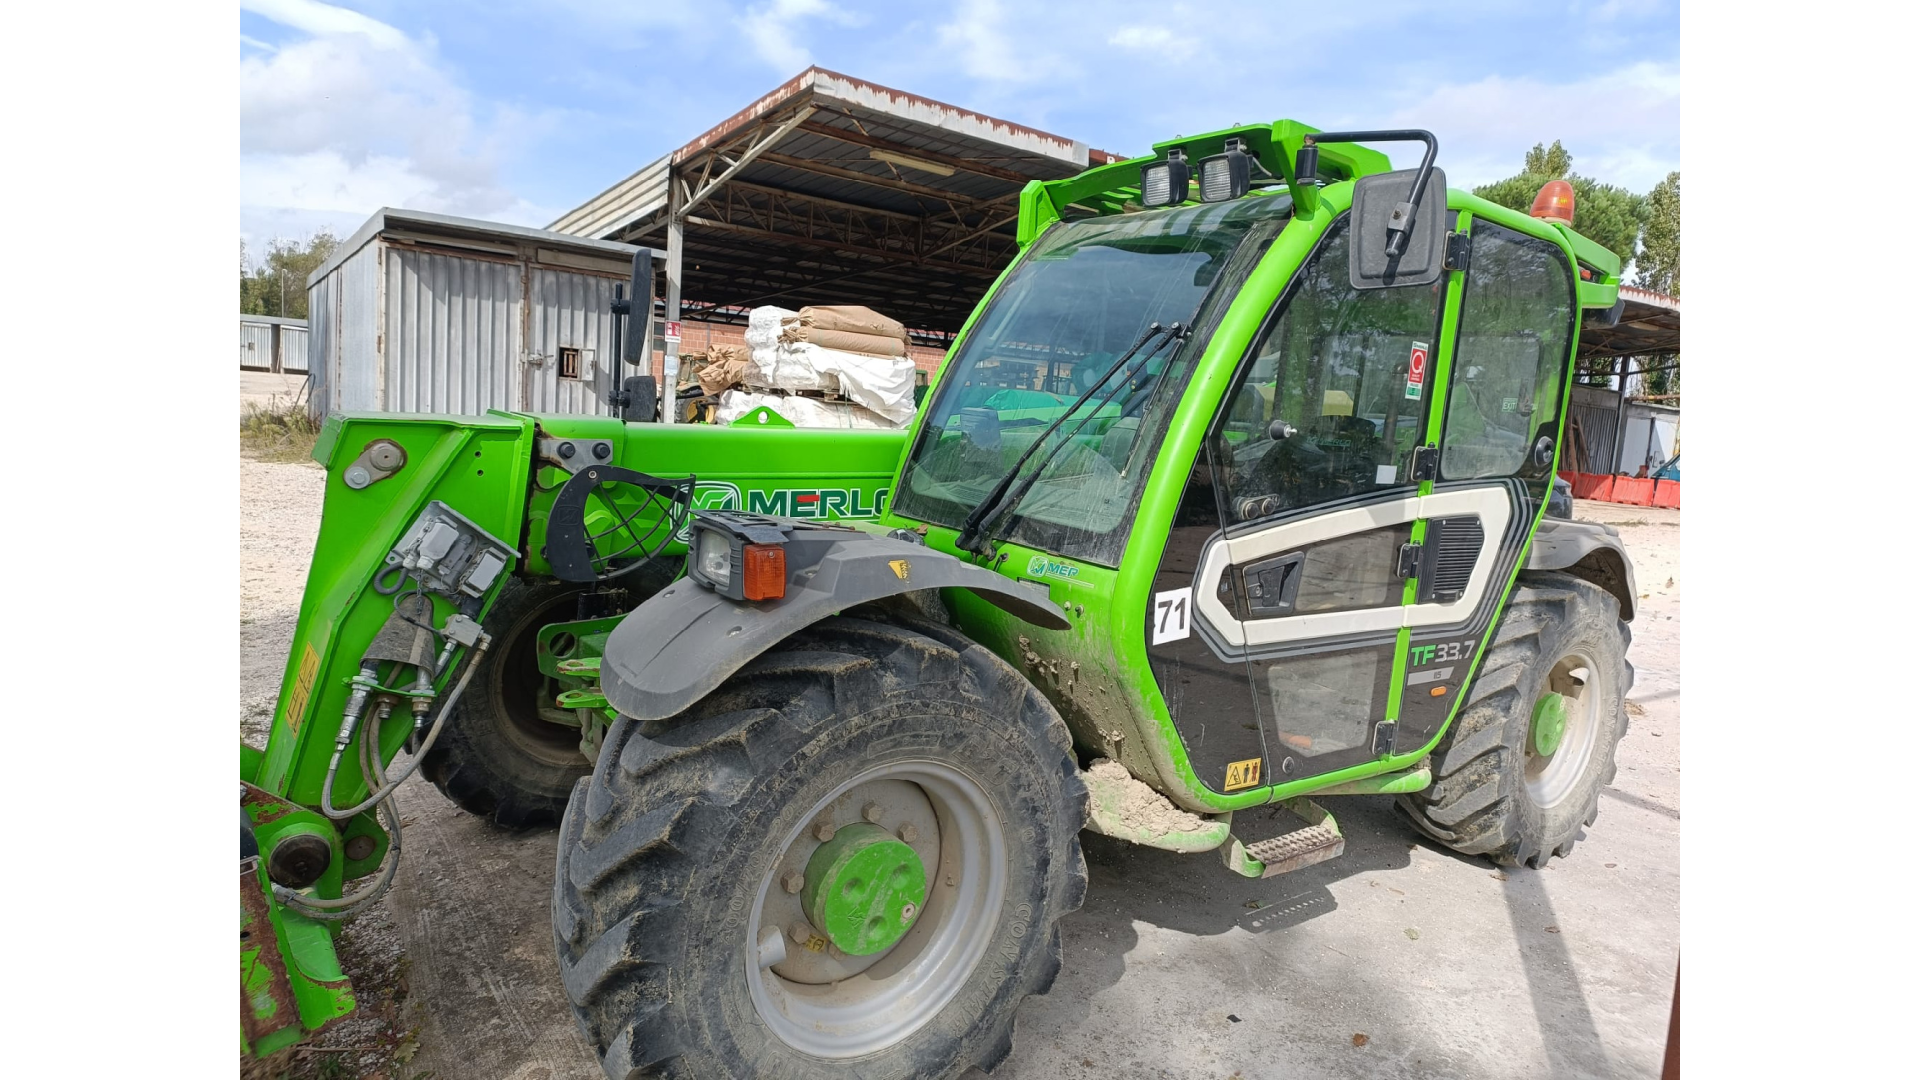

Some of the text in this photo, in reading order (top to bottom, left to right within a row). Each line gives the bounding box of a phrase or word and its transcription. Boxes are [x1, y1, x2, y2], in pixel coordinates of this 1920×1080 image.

[1411, 351, 1424, 374] Q
[1048, 562, 1080, 577] MER
[1157, 597, 1186, 634] 71
